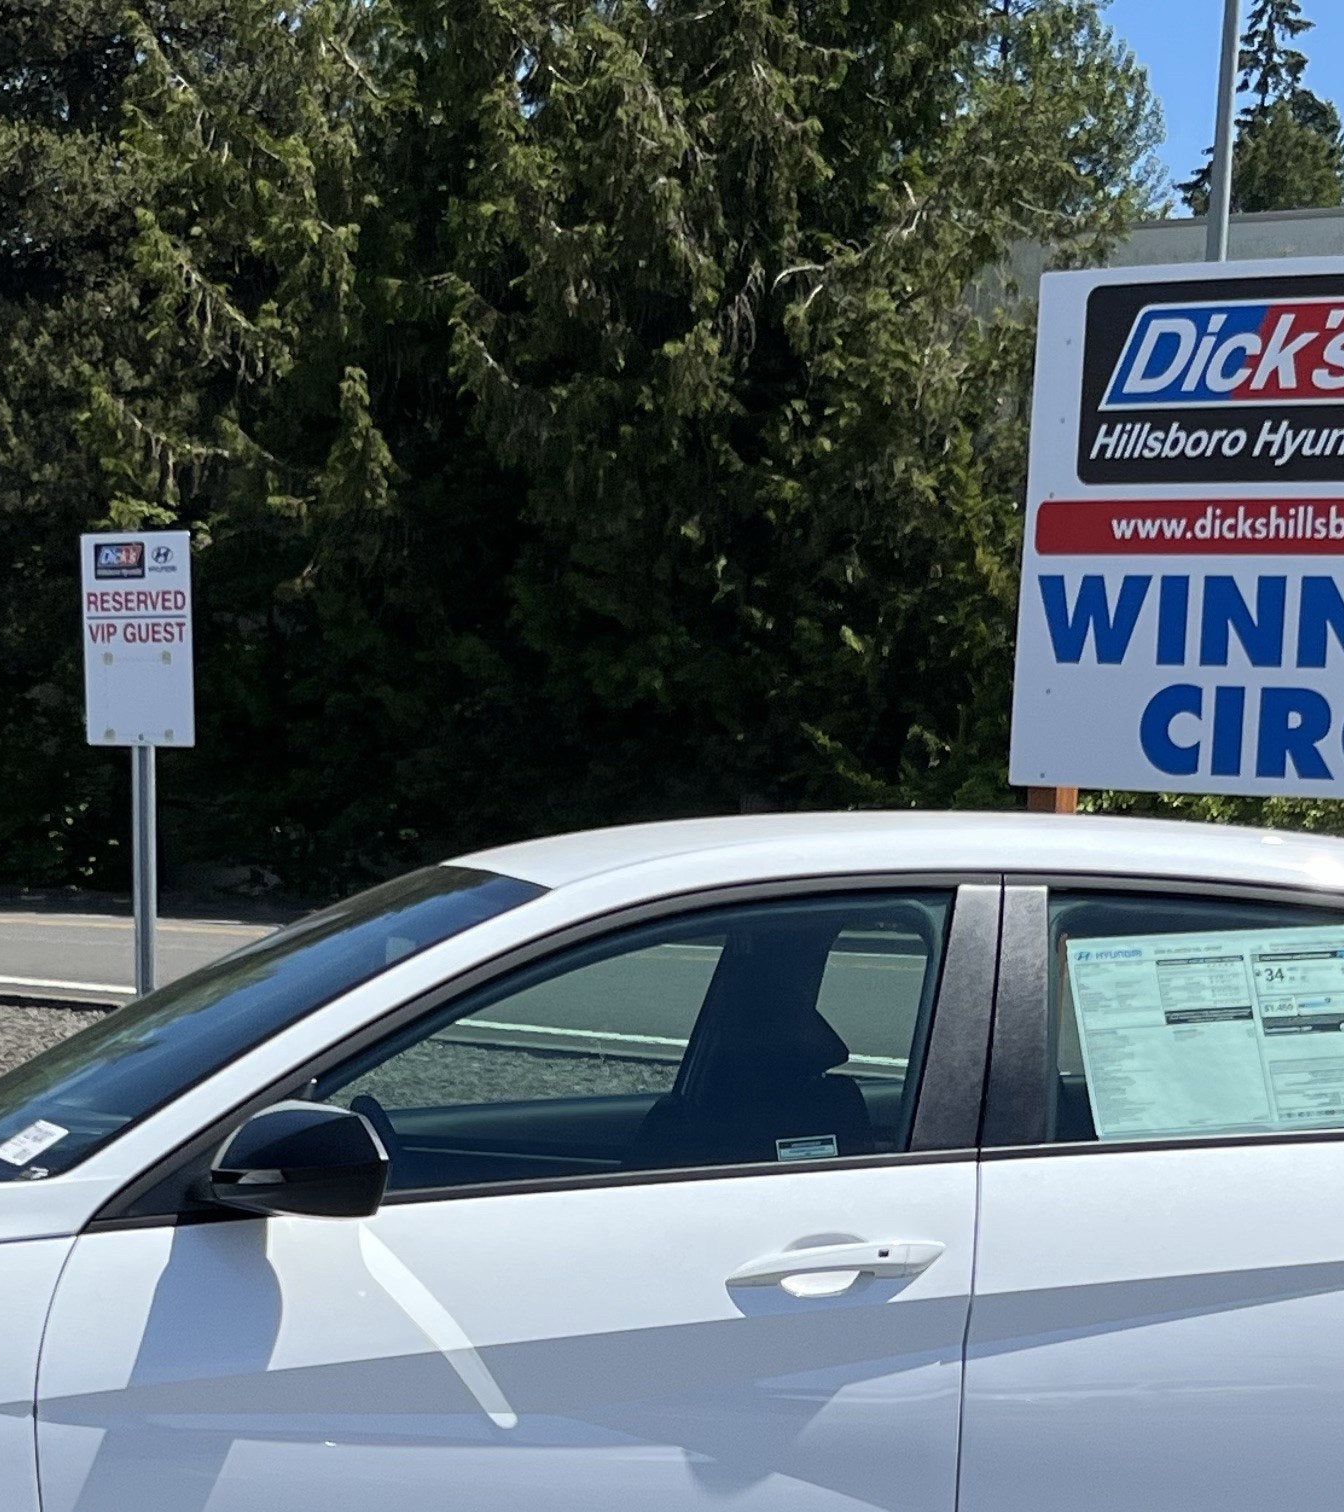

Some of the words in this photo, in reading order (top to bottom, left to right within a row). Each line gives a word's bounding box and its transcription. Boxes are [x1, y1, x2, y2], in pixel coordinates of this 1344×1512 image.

[1089, 420, 1248, 460] Hillsboro
[86, 590, 186, 612] RESERVED
[88, 623, 117, 644] VIP
[123, 622, 186, 643] GUEST
[1264, 968, 1285, 982] 34
